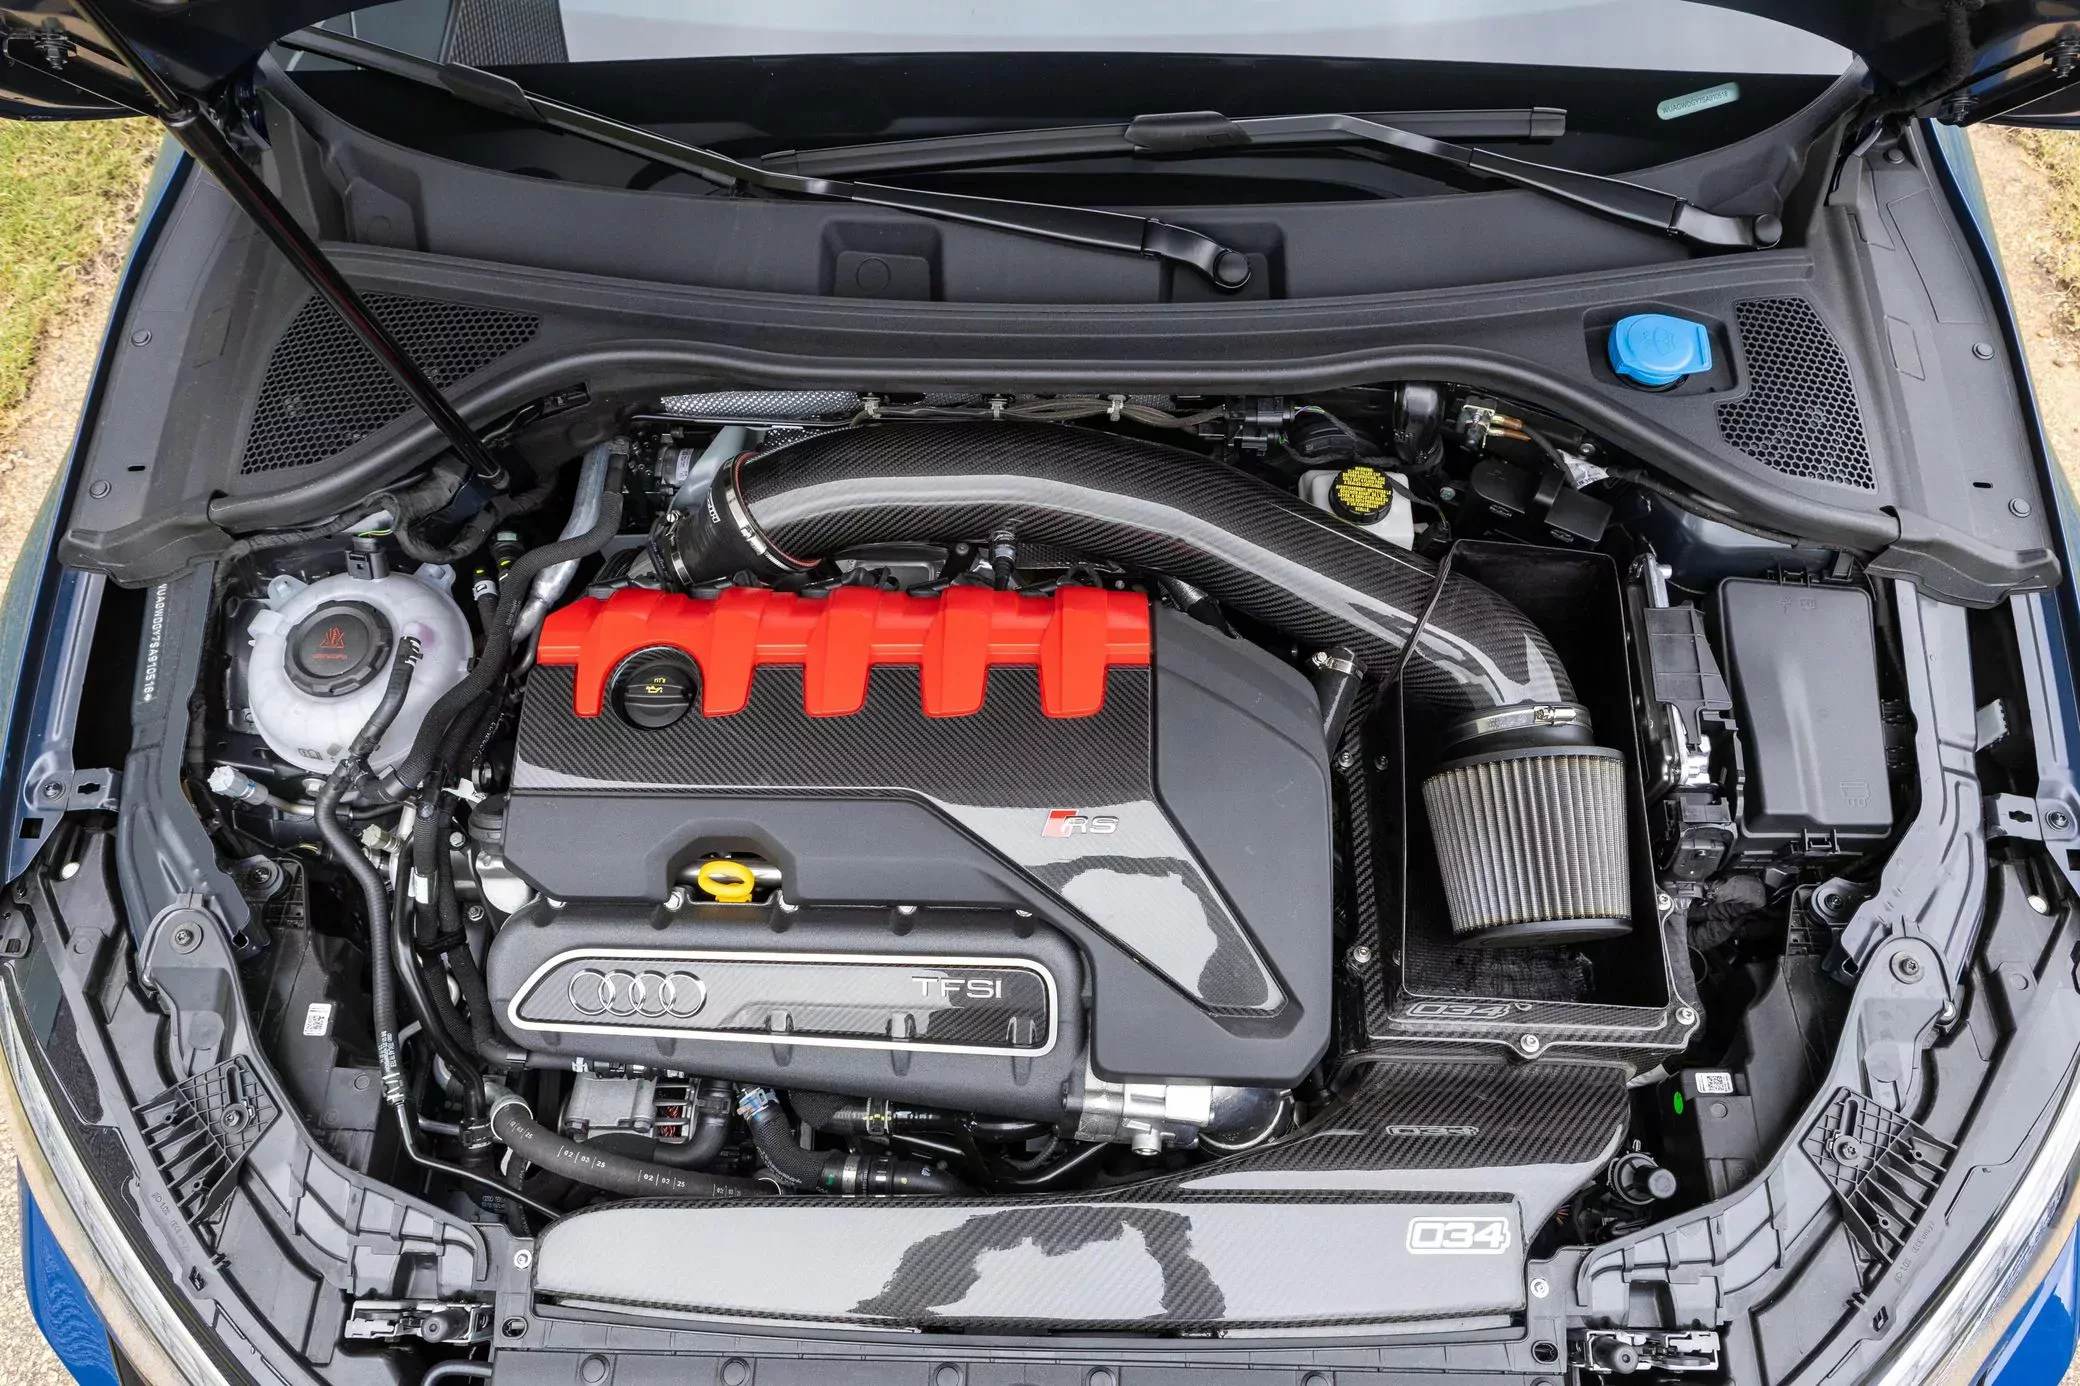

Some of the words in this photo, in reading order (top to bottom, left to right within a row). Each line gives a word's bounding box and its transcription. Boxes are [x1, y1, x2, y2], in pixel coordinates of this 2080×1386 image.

[1061, 815, 1119, 834] RS
[911, 976, 1002, 998] TFSI
[1411, 1003, 1506, 1017] 034
[1389, 1127, 1472, 1135] 034
[1410, 1221, 1505, 1249] 034
